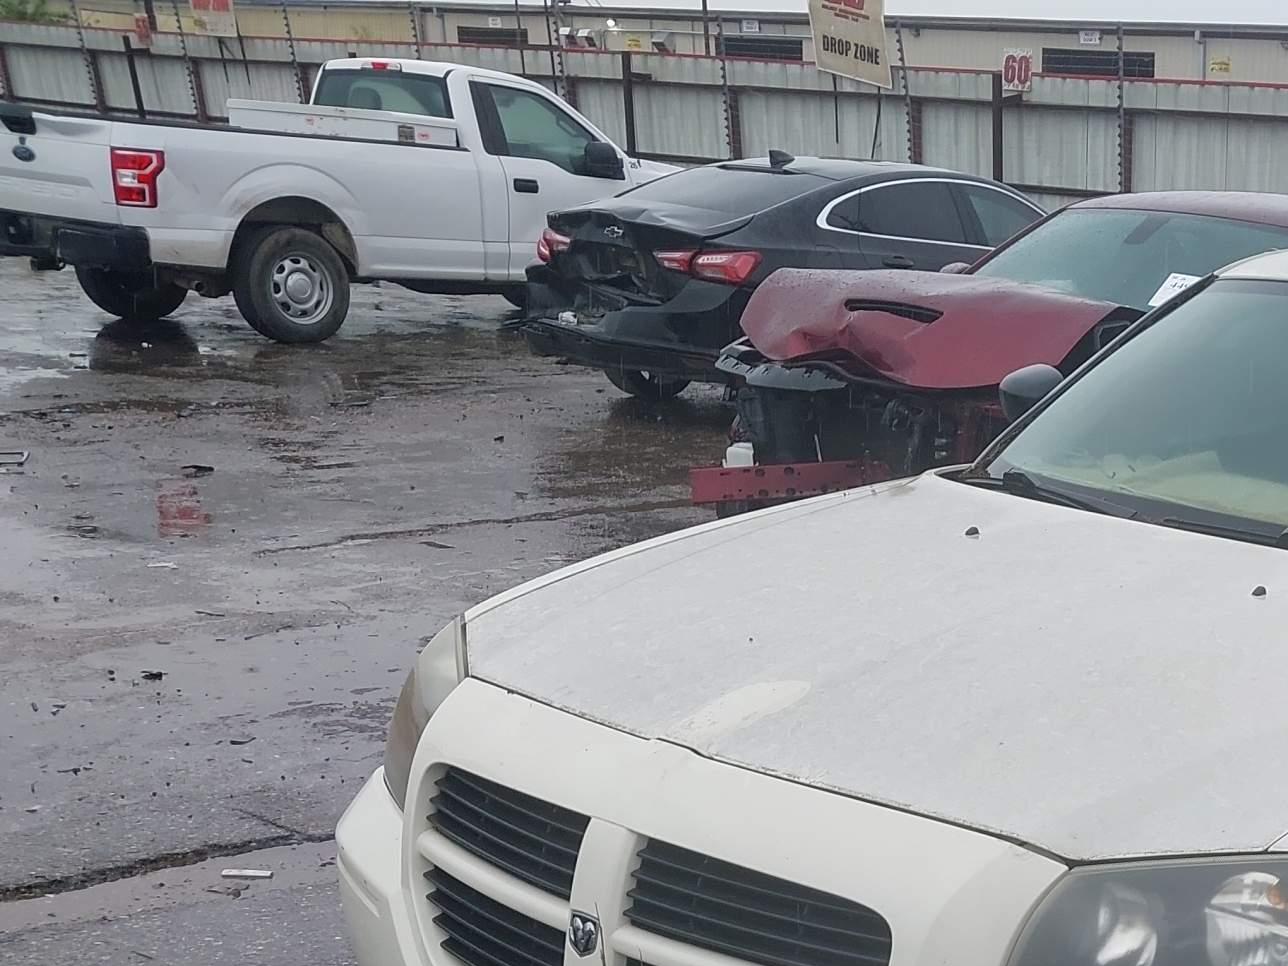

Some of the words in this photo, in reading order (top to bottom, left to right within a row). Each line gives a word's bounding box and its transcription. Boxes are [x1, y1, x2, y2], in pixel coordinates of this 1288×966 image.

[822, 34, 851, 57] DROP
[853, 43, 880, 65] ZONE
[1004, 54, 1030, 85] 60
